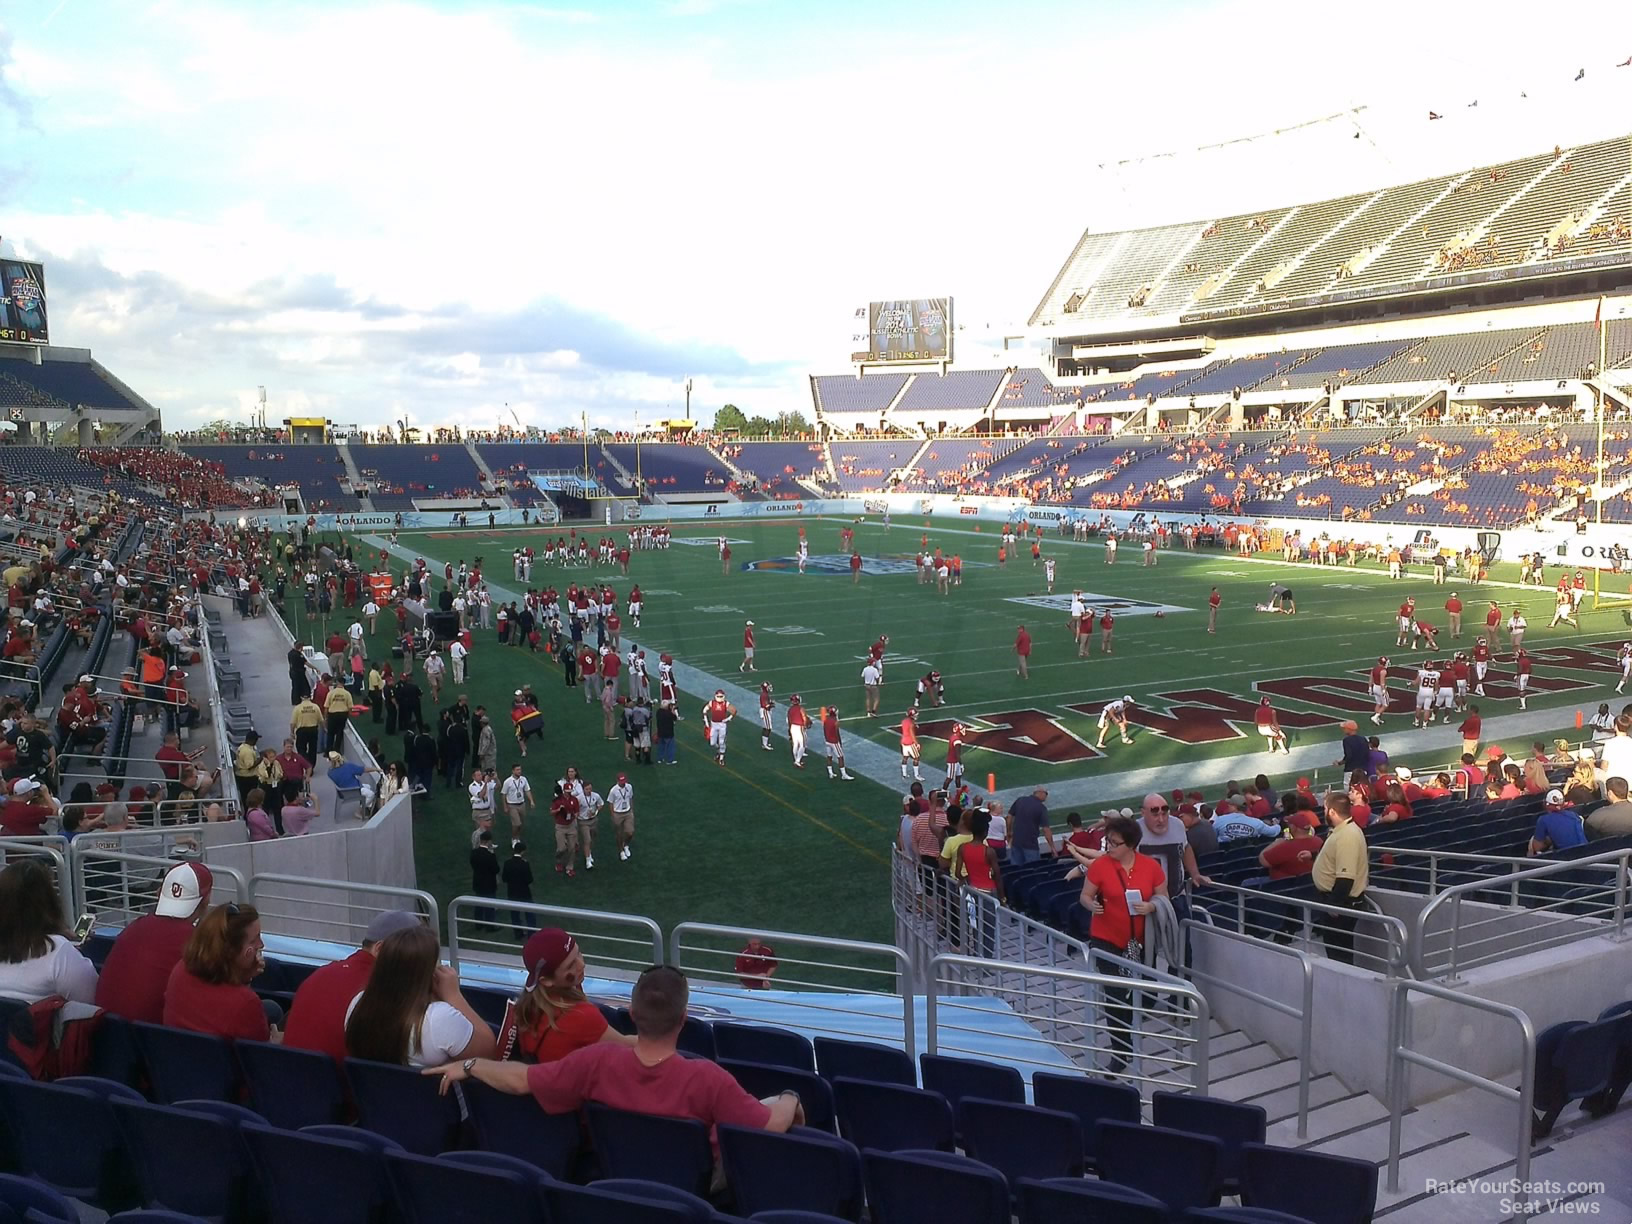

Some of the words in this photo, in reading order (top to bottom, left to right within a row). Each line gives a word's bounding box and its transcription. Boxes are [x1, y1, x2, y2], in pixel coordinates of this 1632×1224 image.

[766, 504, 801, 512] ORLAND
[960, 506, 978, 515] ESPN
[1422, 677, 1437, 689] 89
[171, 882, 183, 898] OU
